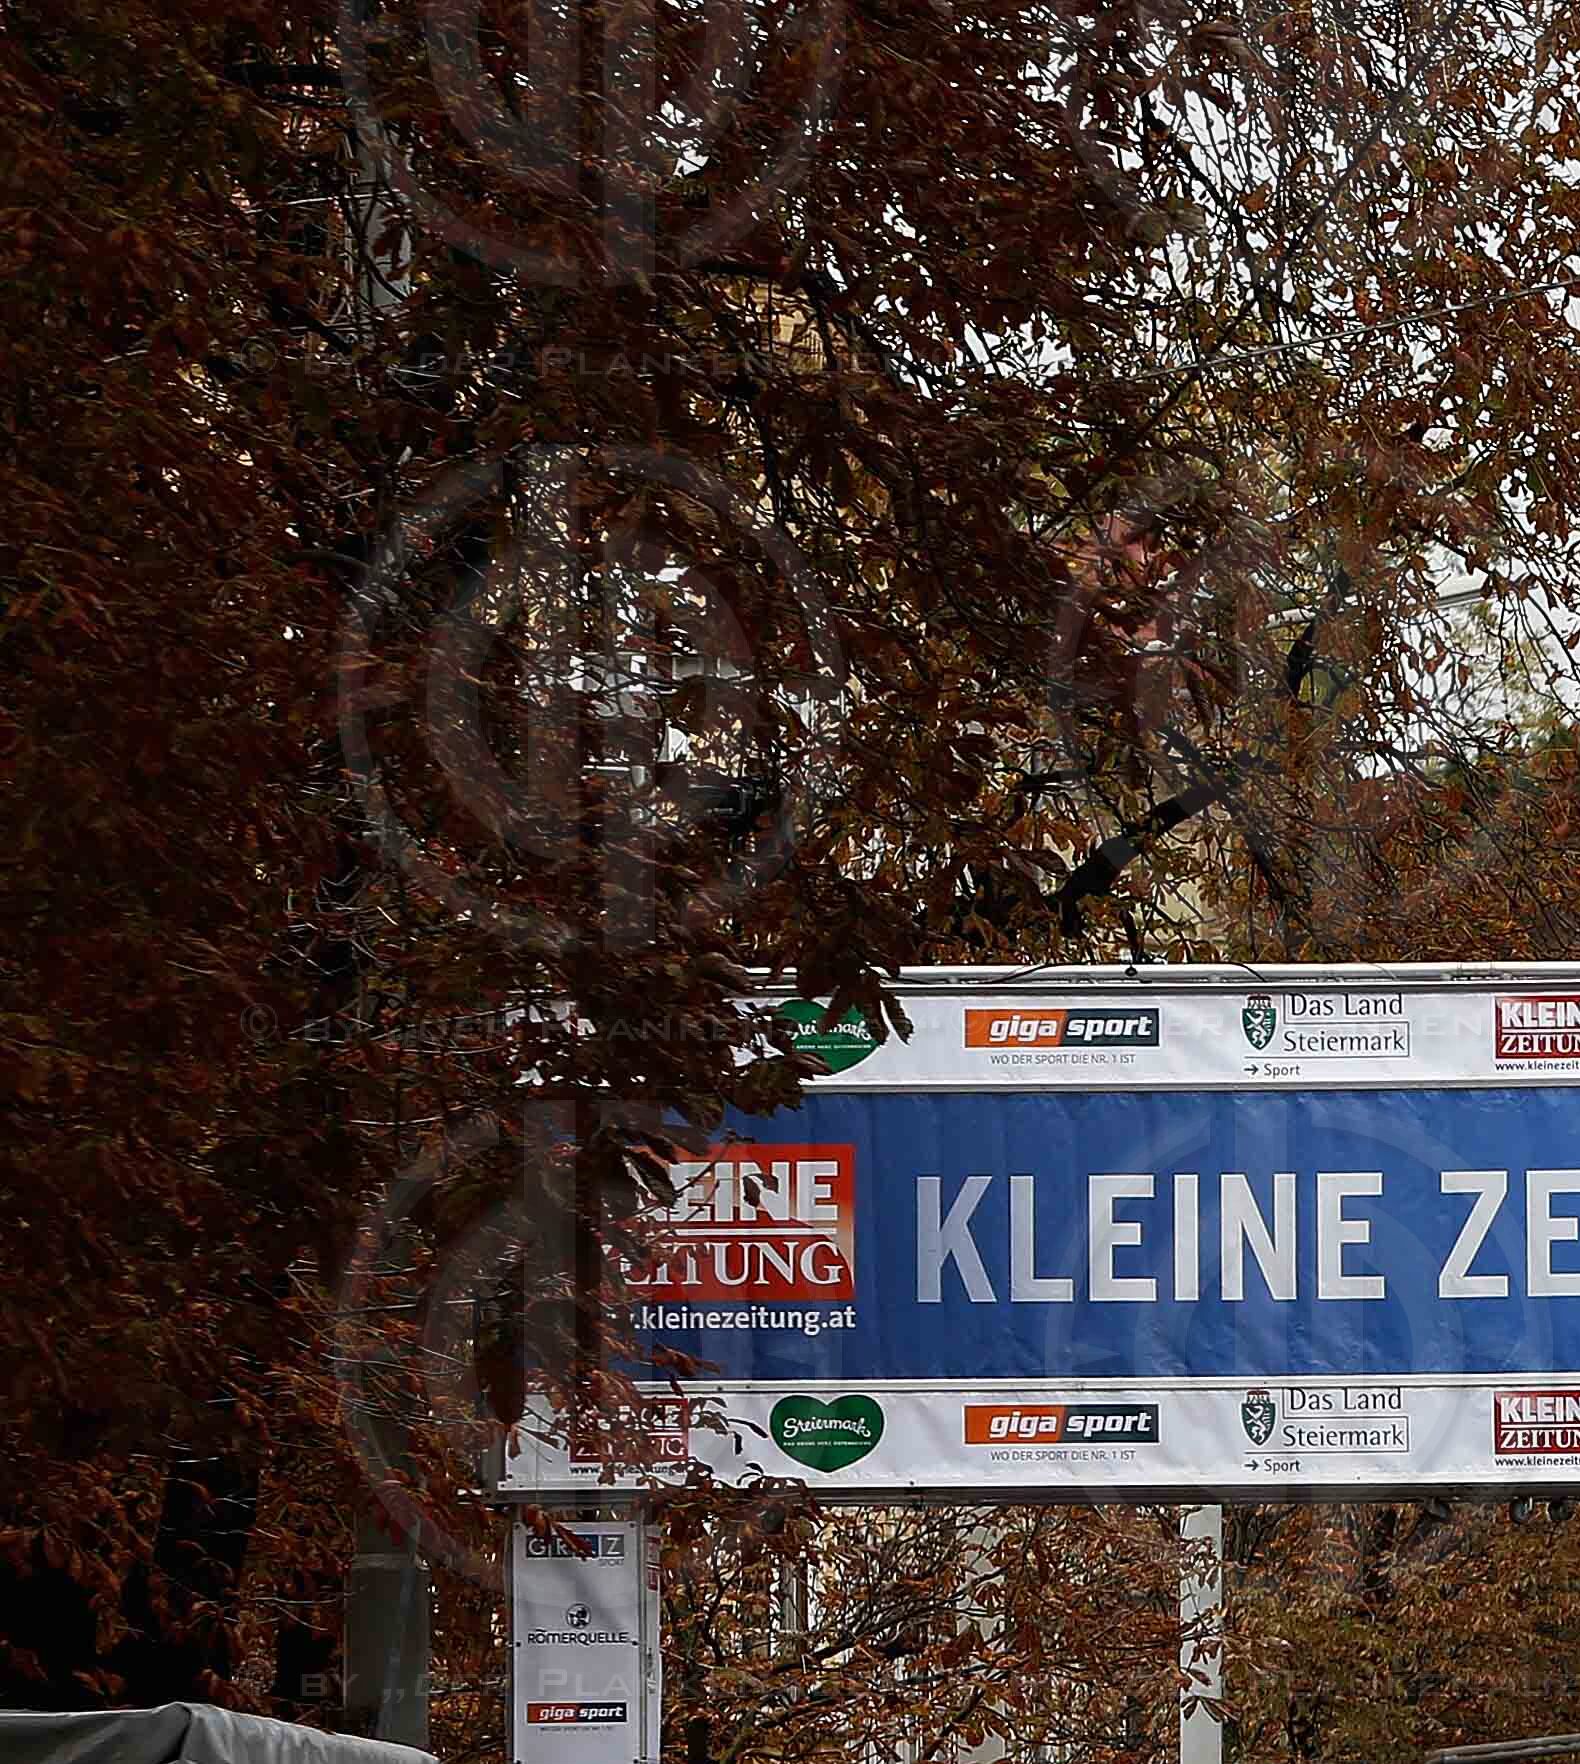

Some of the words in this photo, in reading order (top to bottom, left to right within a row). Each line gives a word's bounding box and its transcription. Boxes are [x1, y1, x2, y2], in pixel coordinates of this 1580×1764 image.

[1290, 994, 1333, 1016] Das
[1344, 993, 1403, 1016] Land
[988, 1015, 1058, 1043] giga
[1065, 1015, 1154, 1042] sport
[1283, 1030, 1405, 1052] Steiermark
[991, 1054, 1010, 1065] WO
[1012, 1054, 1033, 1065] DER
[1035, 1054, 1069, 1065] SPORT
[1072, 1054, 1089, 1065] DIE
[1120, 1054, 1136, 1065] IST
[1264, 1063, 1301, 1077] Sport
[917, 1173, 1386, 1304] KLEINE
[632, 1304, 857, 1336] .kleinezeitung.at
[1289, 1388, 1333, 1411] Das
[1343, 1387, 1403, 1411] Land
[783, 1416, 872, 1439] Steiermark
[988, 1411, 1058, 1440] giga
[1065, 1411, 1154, 1439] sport
[1282, 1425, 1405, 1448] Steiermark
[991, 1450, 1010, 1461] WO
[1012, 1450, 1033, 1461] DER
[1035, 1450, 1069, 1461] SPORT
[1072, 1450, 1089, 1461] DIE
[1120, 1450, 1136, 1461] IST
[1264, 1458, 1301, 1473] Sport
[527, 1536, 622, 1557] GRZ
[539, 1706, 575, 1720] giga
[578, 1706, 624, 1719] sport
